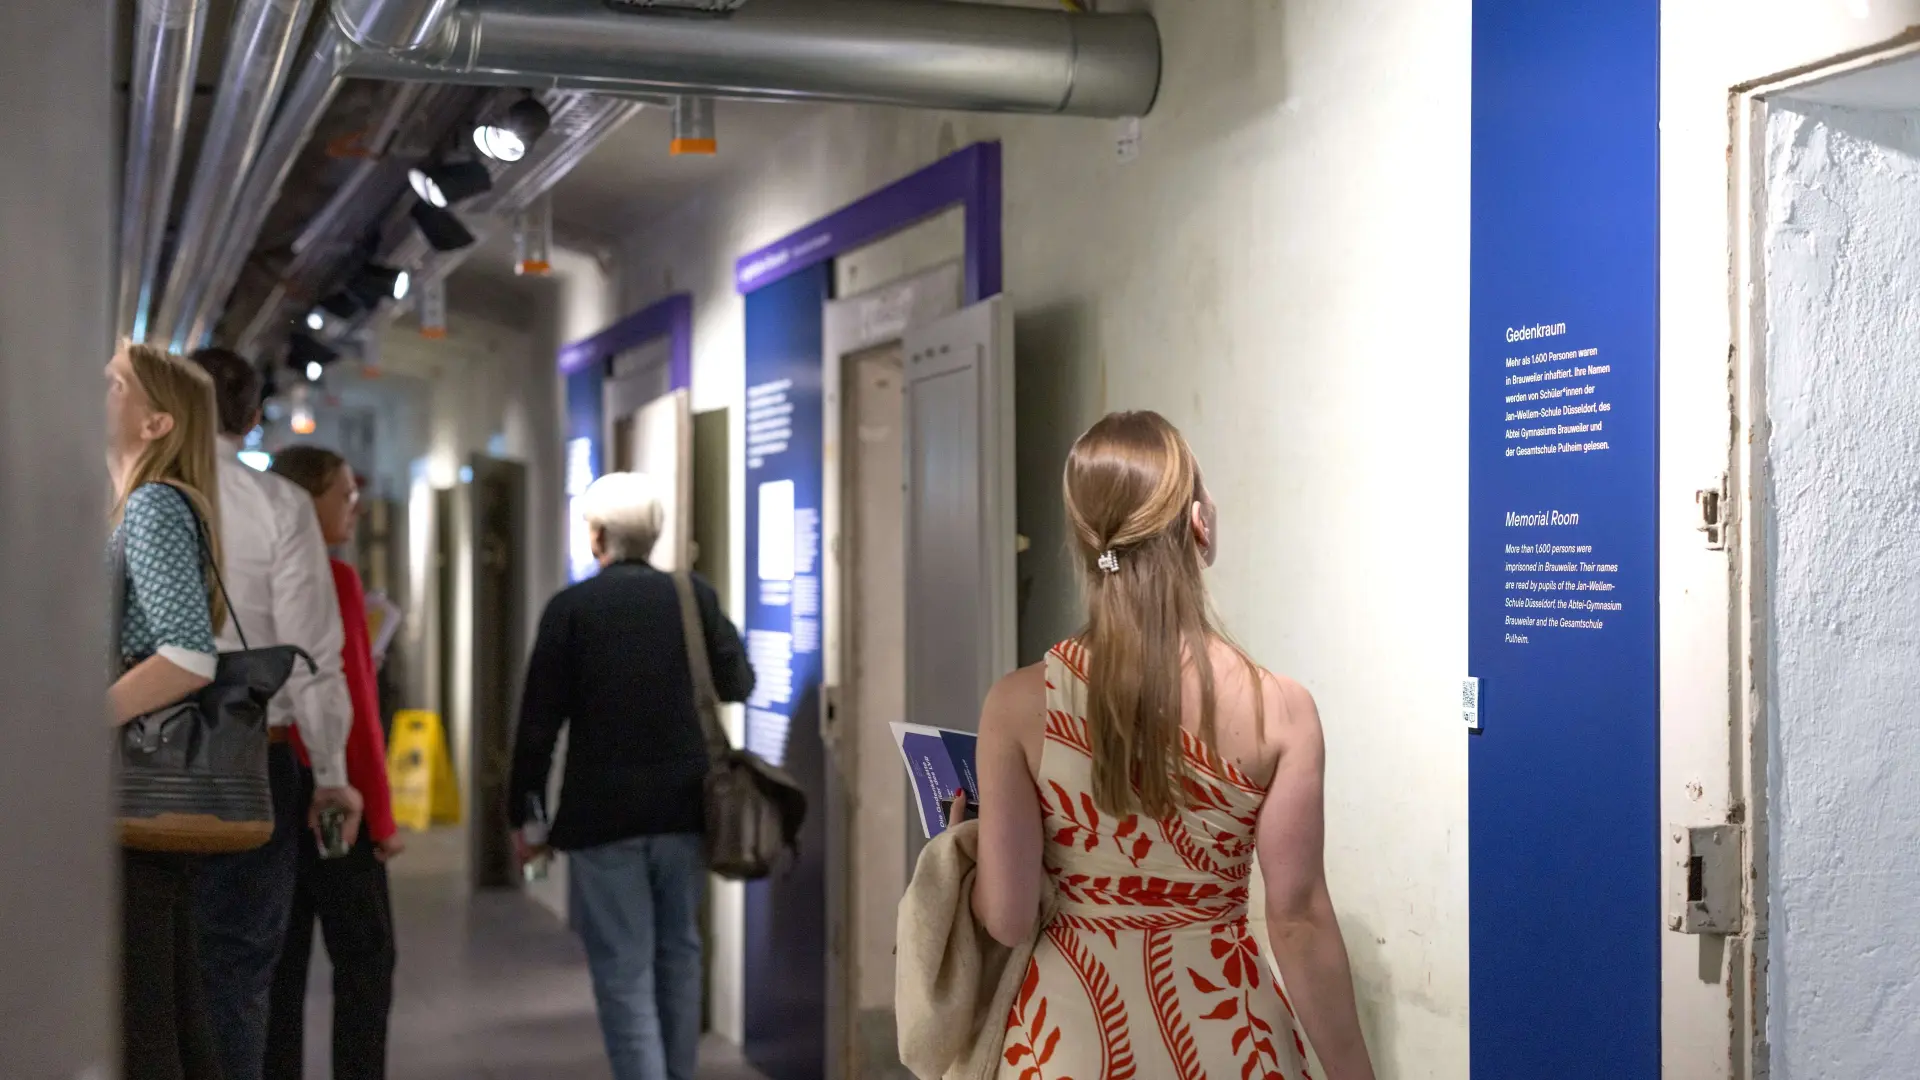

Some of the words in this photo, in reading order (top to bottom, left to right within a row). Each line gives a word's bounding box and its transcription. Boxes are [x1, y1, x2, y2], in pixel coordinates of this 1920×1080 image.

[1506, 322, 1566, 342] Gedenkraum
[1506, 358, 1520, 367] Mehr
[1522, 356, 1530, 366] als
[1549, 351, 1577, 362] Personen
[1578, 347, 1597, 357] waren
[1506, 376, 1511, 385] in
[1513, 373, 1543, 384] Brauweiler
[1544, 369, 1573, 380] inhaftiert.
[1574, 367, 1586, 376] Ihre
[1588, 365, 1610, 375] Namen
[1506, 392, 1526, 403] werden
[1528, 392, 1538, 400] von
[1584, 384, 1595, 394] der
[1505, 406, 1561, 421] Jan-Wellem-Schule
[1563, 403, 1597, 415] Düsseldorf,
[1599, 402, 1610, 411] des
[1505, 429, 1519, 439] Abtei
[1521, 426, 1556, 439] Gymnasiums
[1558, 423, 1589, 434] Brauweiler
[1590, 421, 1602, 431] und
[1506, 447, 1515, 457] der
[1516, 444, 1556, 456] Gesamtschule
[1558, 442, 1582, 452] Pulheim
[1584, 441, 1609, 453] gelesen.
[1506, 511, 1548, 526] Memorial
[1551, 510, 1579, 525] Room
[1505, 544, 1520, 554] More
[1521, 544, 1533, 553] than
[1536, 544, 1551, 554] 1,600
[1552, 545, 1576, 555] persons
[1577, 545, 1592, 553] were
[1505, 562, 1536, 574] imprisoned
[1538, 562, 1543, 571] in
[1545, 562, 1577, 572] Brauweiler.
[1580, 562, 1595, 571] Their
[1596, 564, 1618, 572] names
[1505, 582, 1514, 590] are
[1516, 580, 1529, 590] read
[1530, 580, 1537, 592] by
[1538, 581, 1556, 592] pupils
[1558, 581, 1564, 590] of
[1565, 581, 1575, 590] the
[1576, 581, 1615, 591] Jan-Wellem-
[1505, 598, 1524, 607] Schule
[1525, 598, 1556, 609] Düsseldorf,
[1557, 600, 1567, 609] the
[1568, 600, 1622, 612] Abtei-Gymnasium
[1505, 616, 1535, 626] Brauweiler
[1536, 617, 1548, 626] and
[1549, 617, 1558, 627] the
[1560, 618, 1603, 629] Gesamtschule
[1505, 633, 1529, 644] Pulheim.
